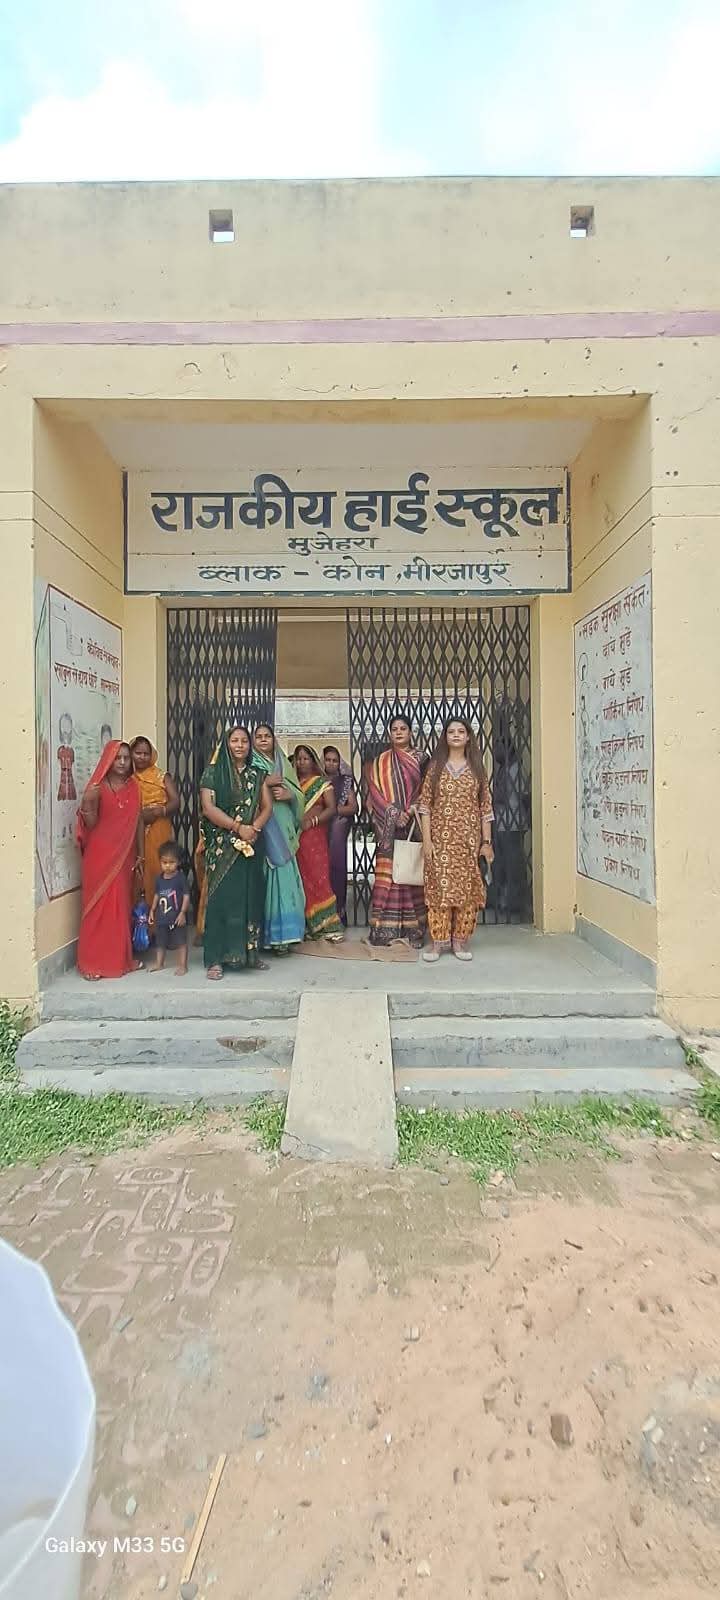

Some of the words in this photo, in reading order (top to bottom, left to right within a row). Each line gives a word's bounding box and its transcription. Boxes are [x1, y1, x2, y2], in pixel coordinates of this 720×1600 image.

[151, 473, 337, 532] राजकीय
[344, 472, 430, 534] हाई
[434, 487, 563, 538] स्कूल
[288, 532, 379, 556] मुजेहरा
[197, 565, 286, 584] ब्लाक
